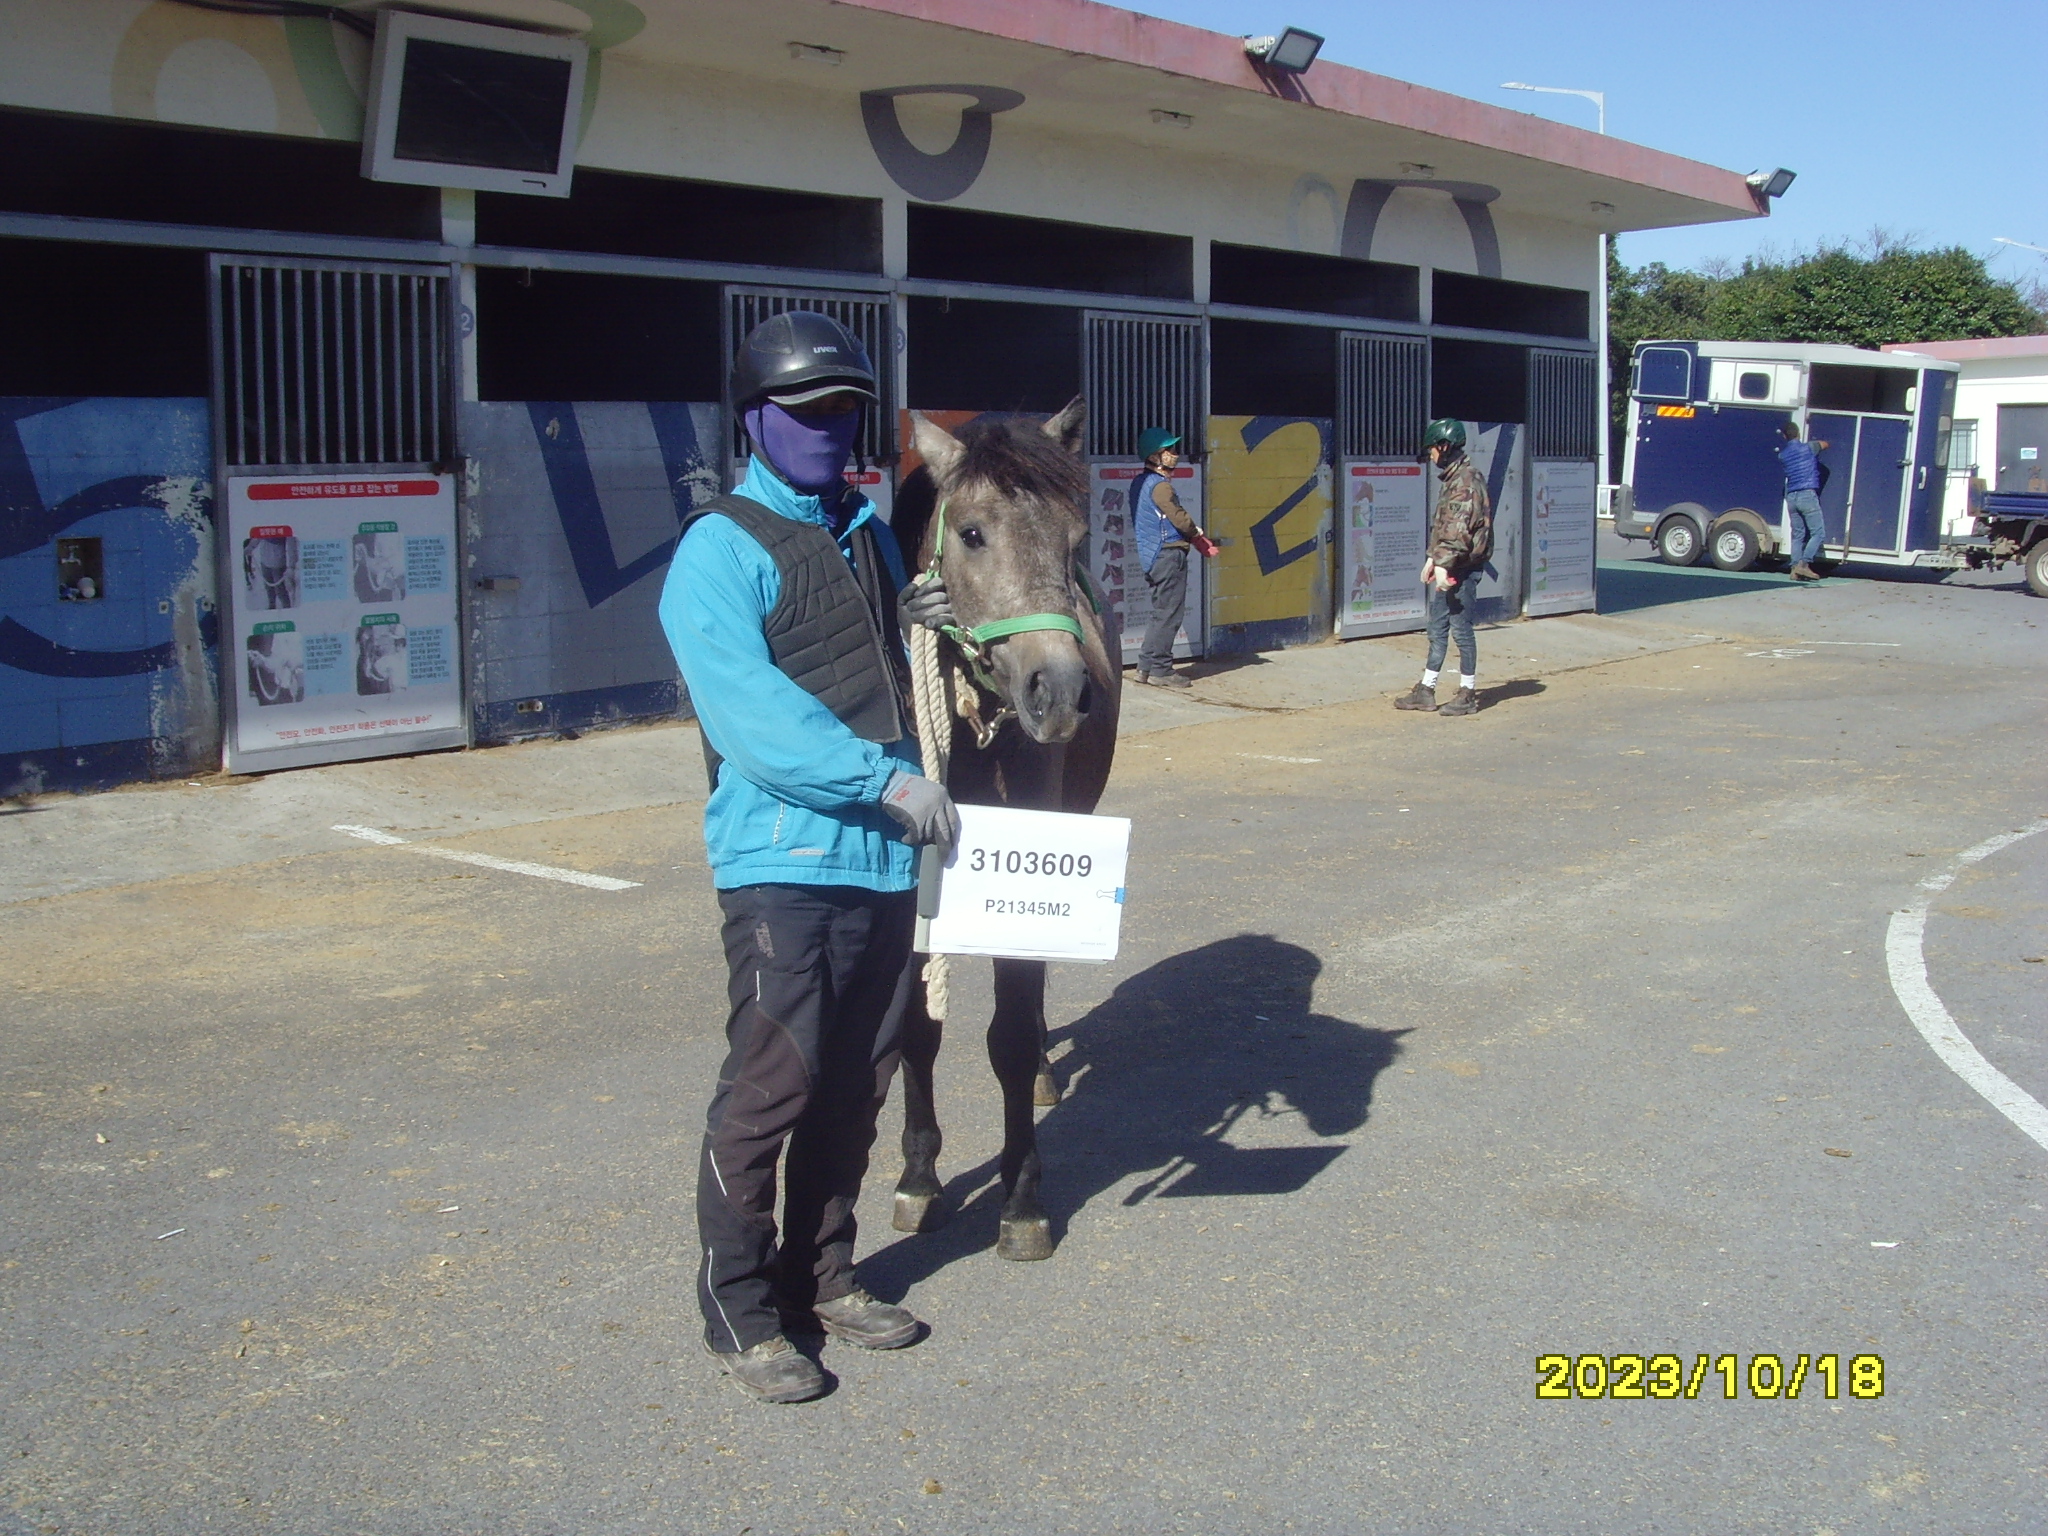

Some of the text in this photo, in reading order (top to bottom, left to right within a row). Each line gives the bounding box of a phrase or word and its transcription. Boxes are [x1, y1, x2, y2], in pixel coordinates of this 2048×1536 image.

[291, 483, 399, 496] 안전하게 유도용 로프 잡는 방법
[970, 848, 1092, 877] 3103609
[985, 899, 1071, 917] P21345M2
